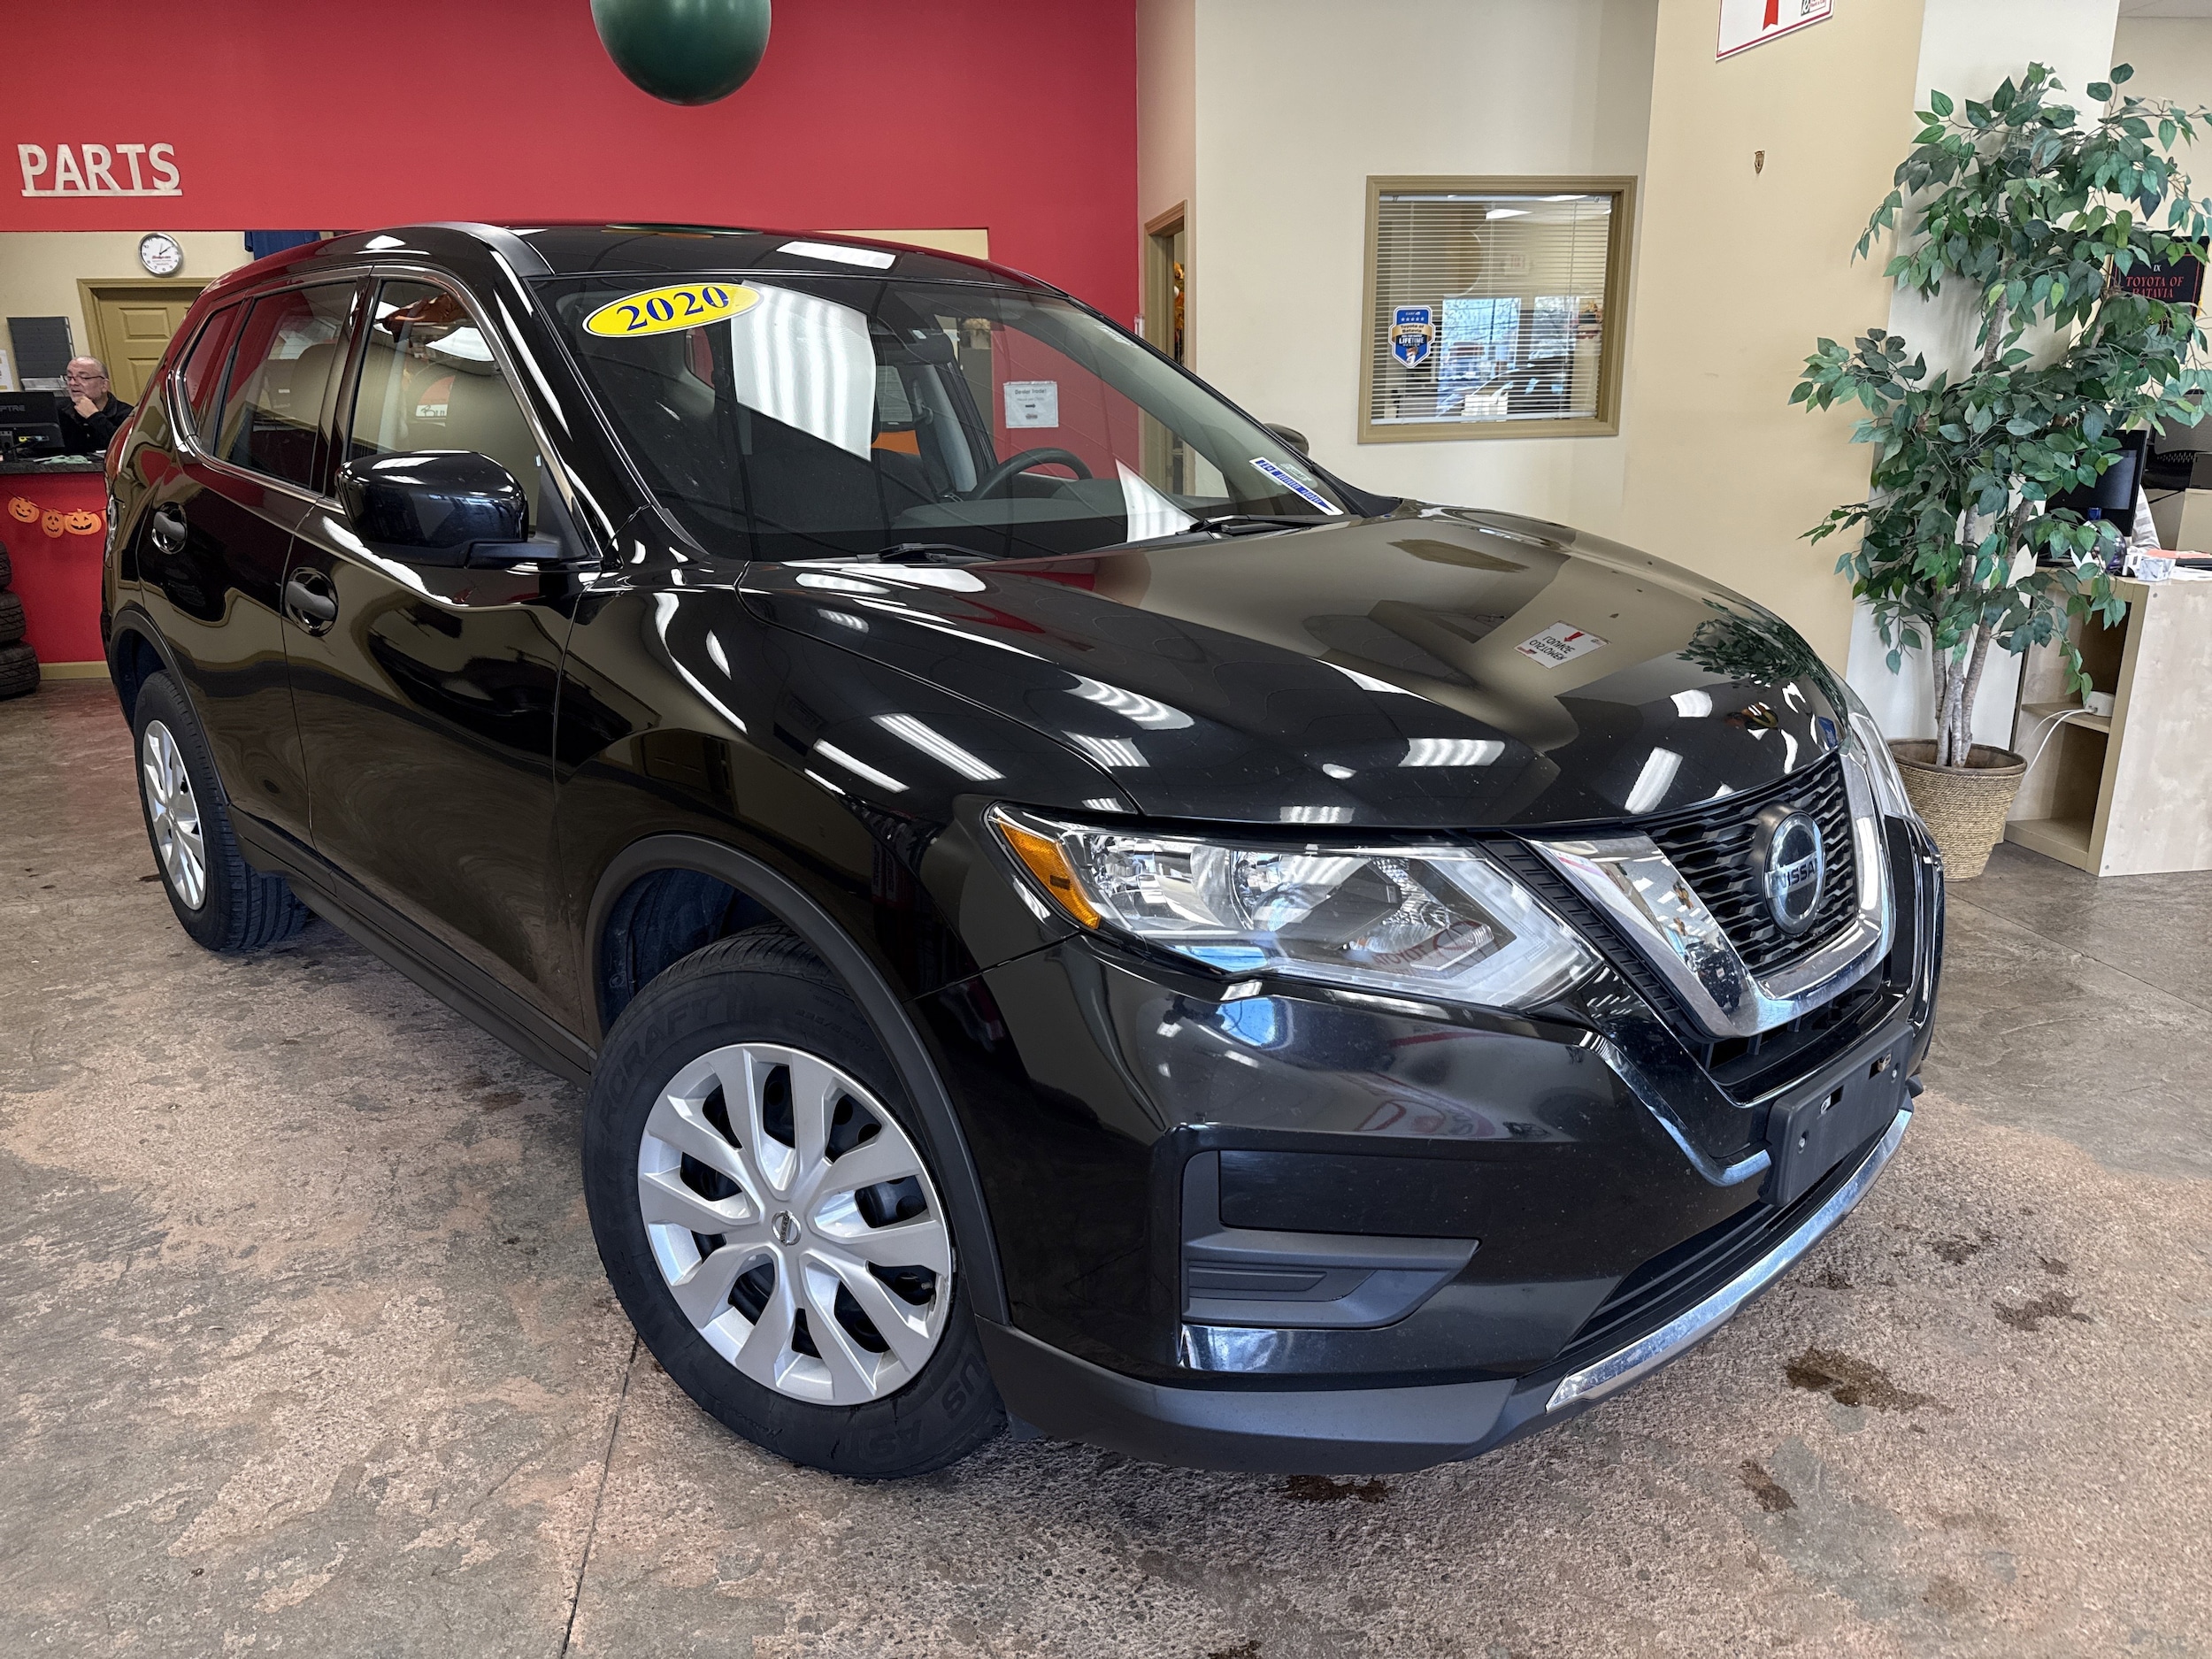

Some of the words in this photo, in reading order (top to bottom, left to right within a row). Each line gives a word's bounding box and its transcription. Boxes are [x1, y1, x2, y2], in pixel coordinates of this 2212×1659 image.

[17, 142, 181, 196] PARTS
[2125, 276, 2165, 288] TOYOTA
[2170, 276, 2185, 288] OF
[2132, 288, 2174, 298] BATAVIA
[616, 286, 730, 332] 2020
